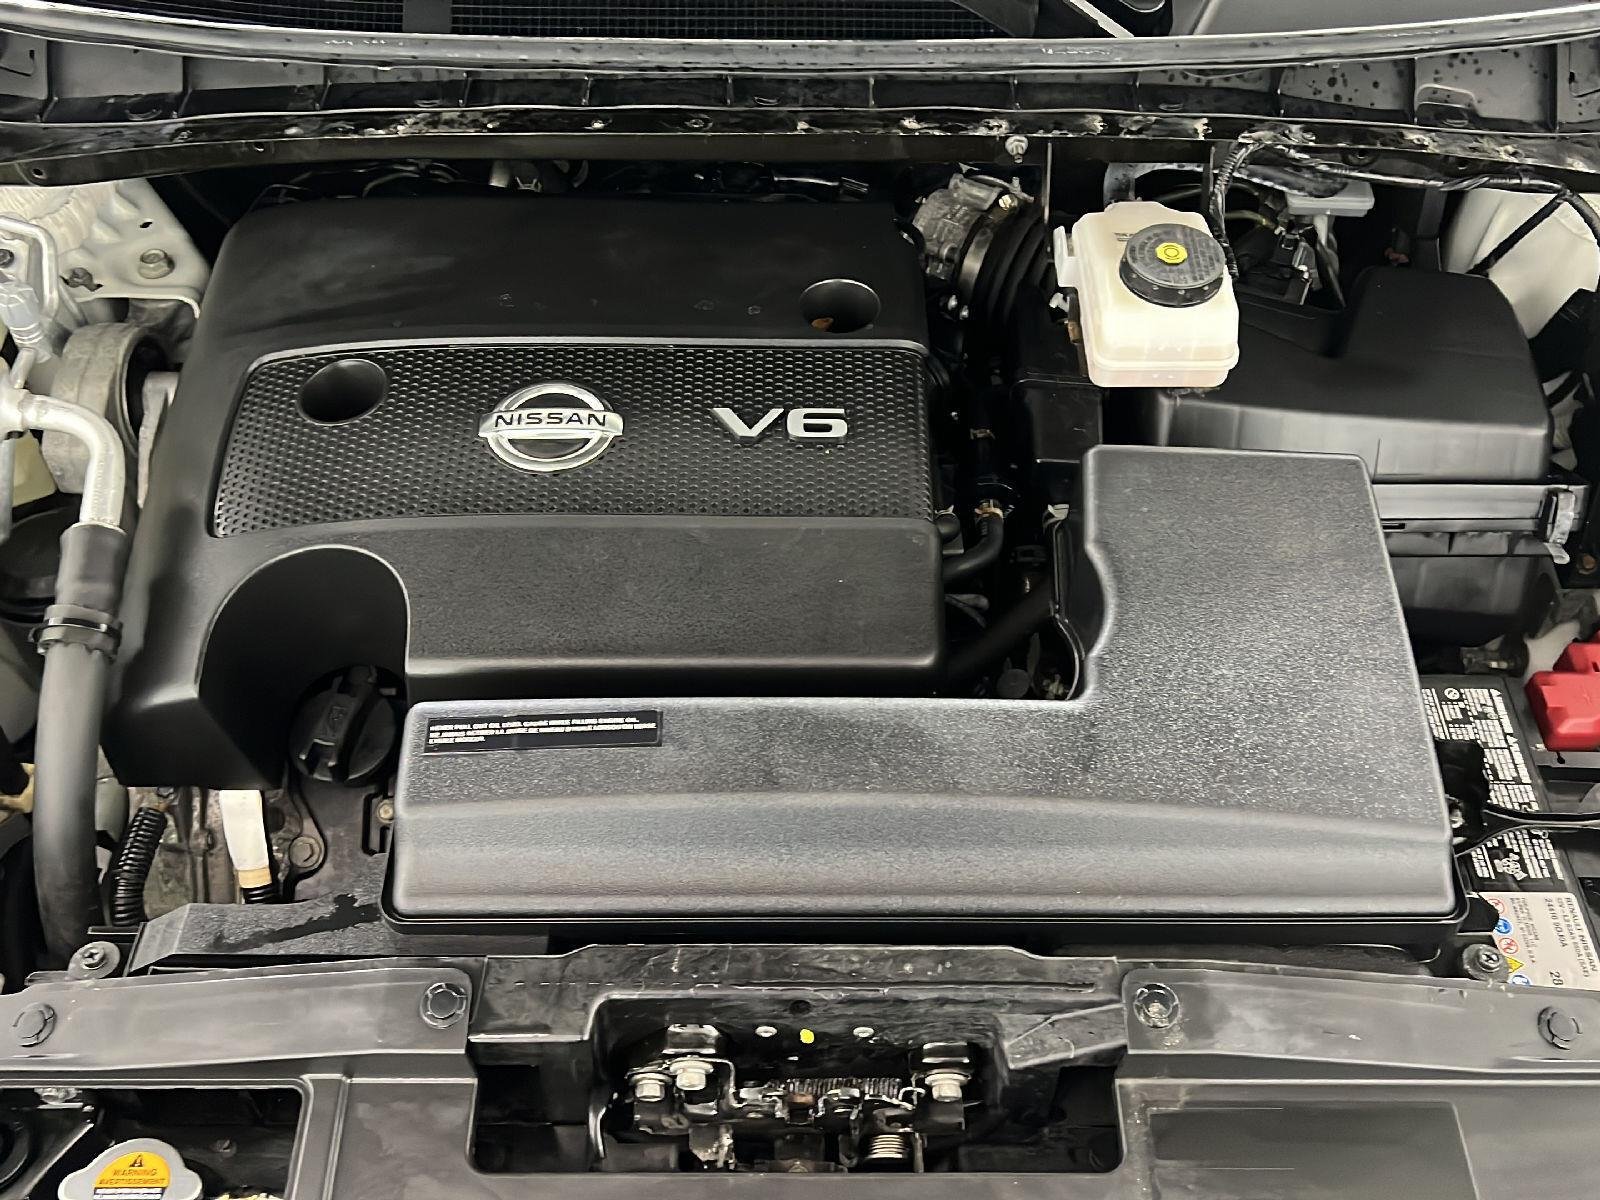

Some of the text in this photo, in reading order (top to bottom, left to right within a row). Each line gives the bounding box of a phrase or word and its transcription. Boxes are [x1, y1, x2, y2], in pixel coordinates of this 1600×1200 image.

[494, 412, 606, 427] NISSAN
[711, 407, 849, 442] V6
[1565, 897, 1597, 971] RENAULT NISSAN
